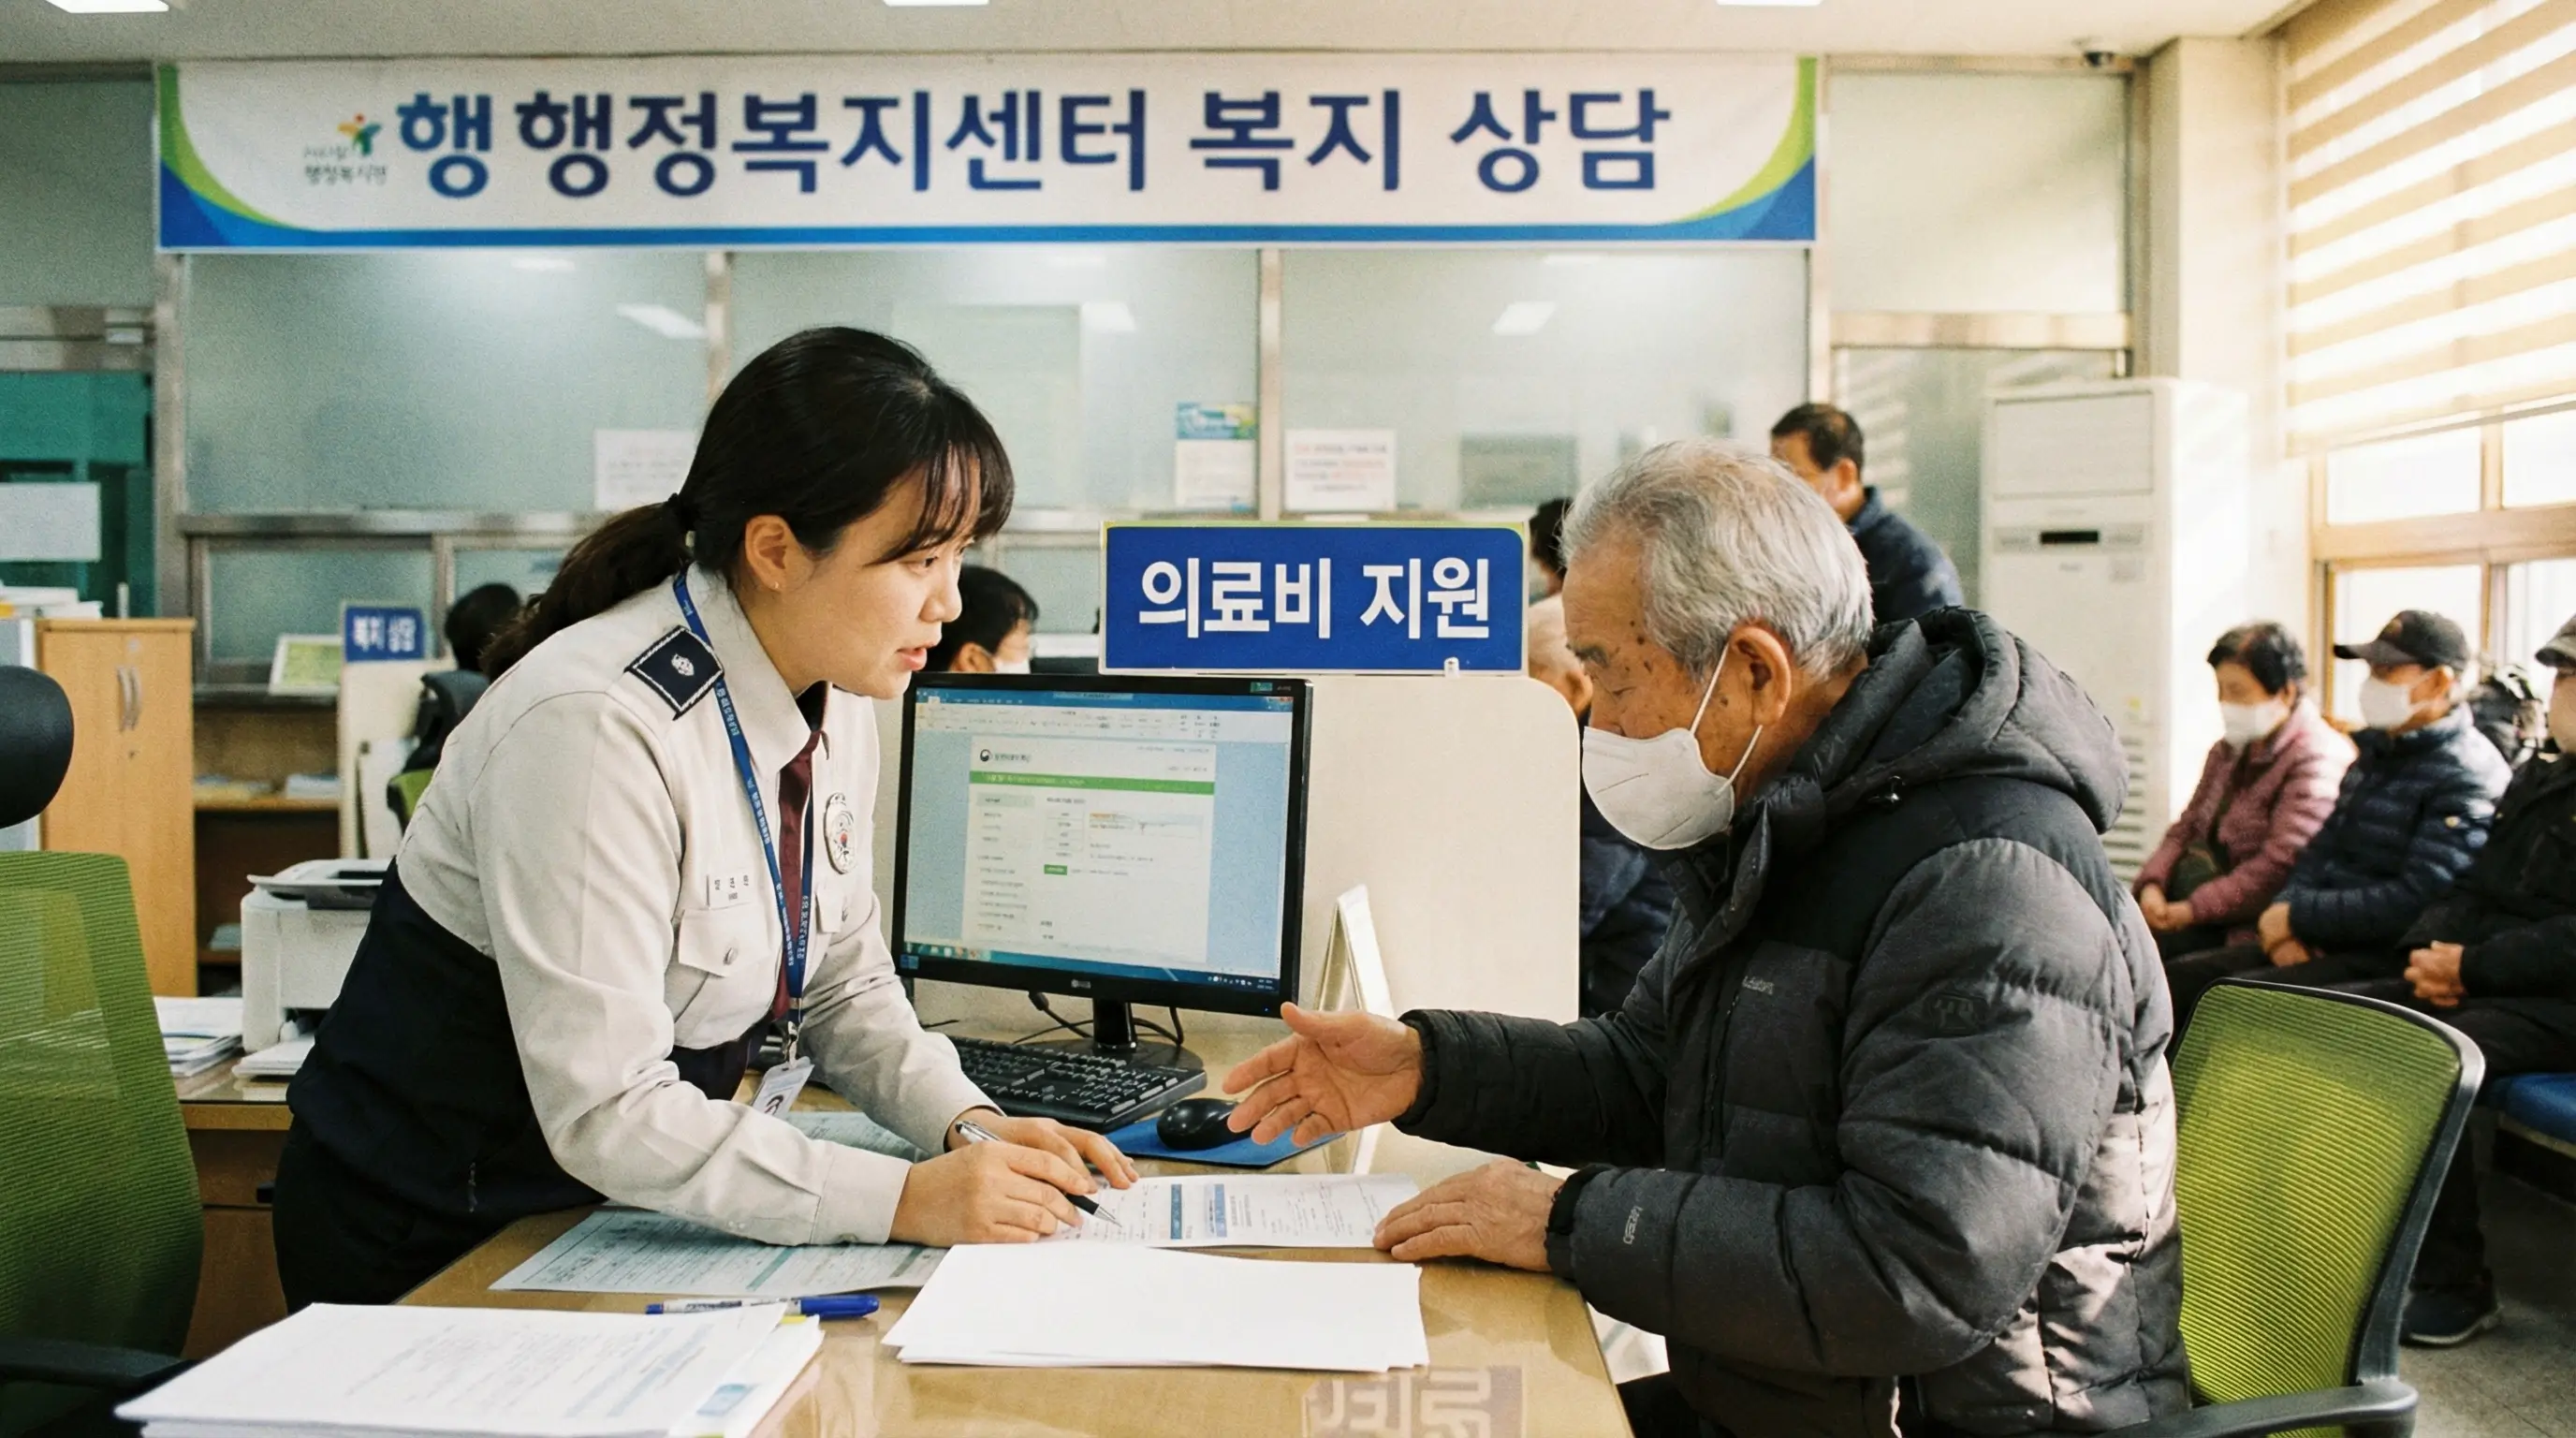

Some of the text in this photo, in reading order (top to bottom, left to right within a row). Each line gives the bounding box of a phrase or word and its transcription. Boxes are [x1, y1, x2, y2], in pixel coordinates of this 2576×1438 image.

[1189, 90, 1400, 191] 복지
[1450, 89, 1671, 193] 상담
[1138, 557, 1490, 638] 의료비 지원
